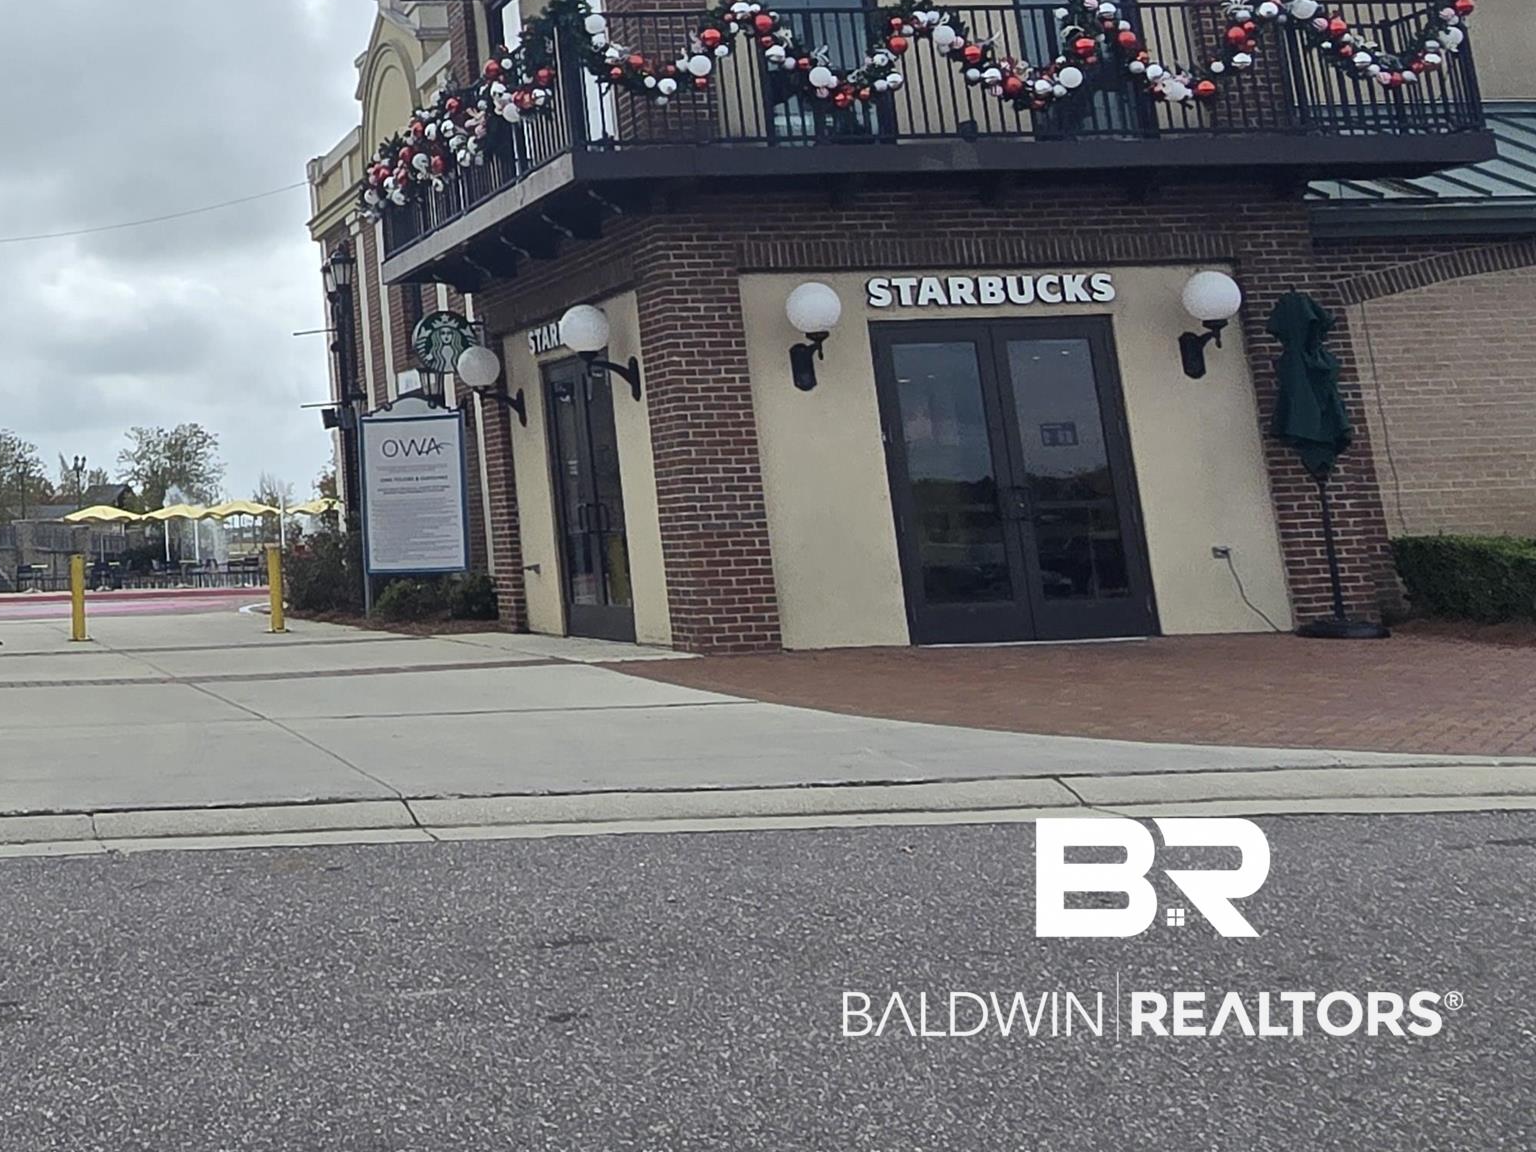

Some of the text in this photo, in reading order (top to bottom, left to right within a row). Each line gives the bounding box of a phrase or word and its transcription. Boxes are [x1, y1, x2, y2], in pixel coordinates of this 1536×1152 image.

[867, 273, 1115, 308] STARBUCKS
[527, 321, 564, 355] STAR
[382, 437, 446, 458] OWA
